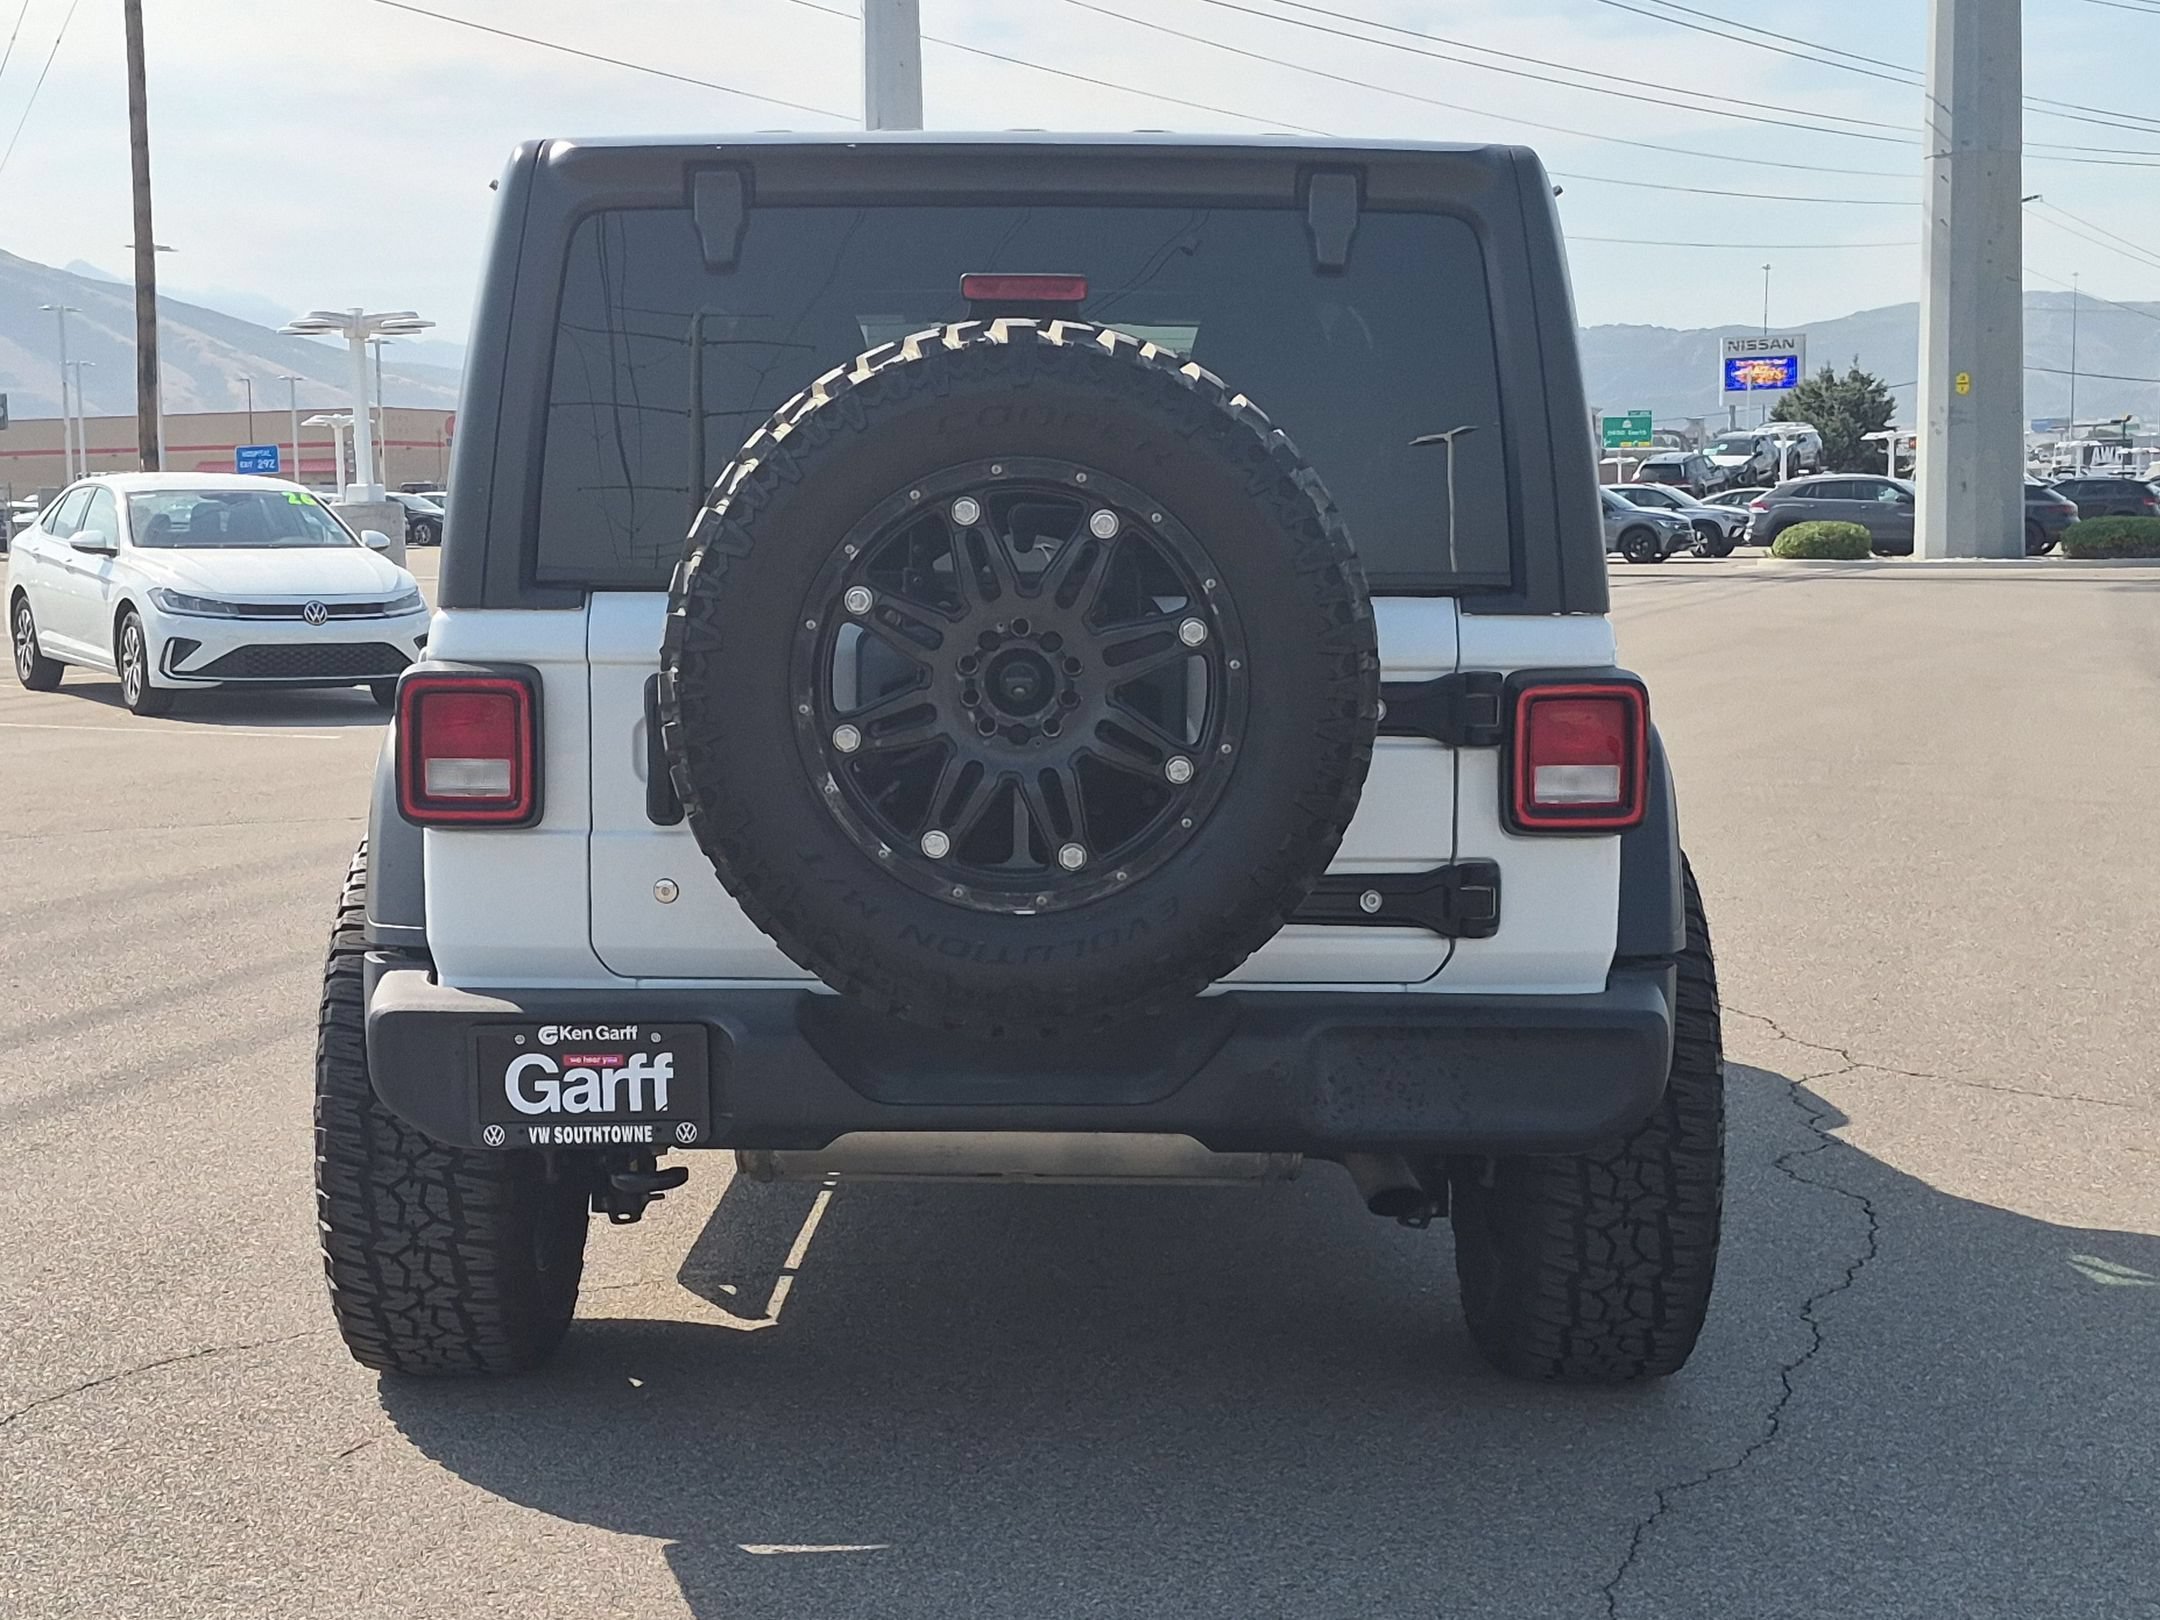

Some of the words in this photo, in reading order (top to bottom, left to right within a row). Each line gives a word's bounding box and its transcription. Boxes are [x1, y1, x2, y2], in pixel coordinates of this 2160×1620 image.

[1727, 338, 1795, 352] NISSAN
[257, 459, 276, 469] 292
[898, 896, 1179, 965] EVOLUTION
[559, 1025, 593, 1041] Ken
[595, 1025, 638, 1041] Garff
[504, 1052, 674, 1115] Garff
[528, 1126, 551, 1144] VW
[554, 1125, 653, 1144] SOUTHTOWNE
